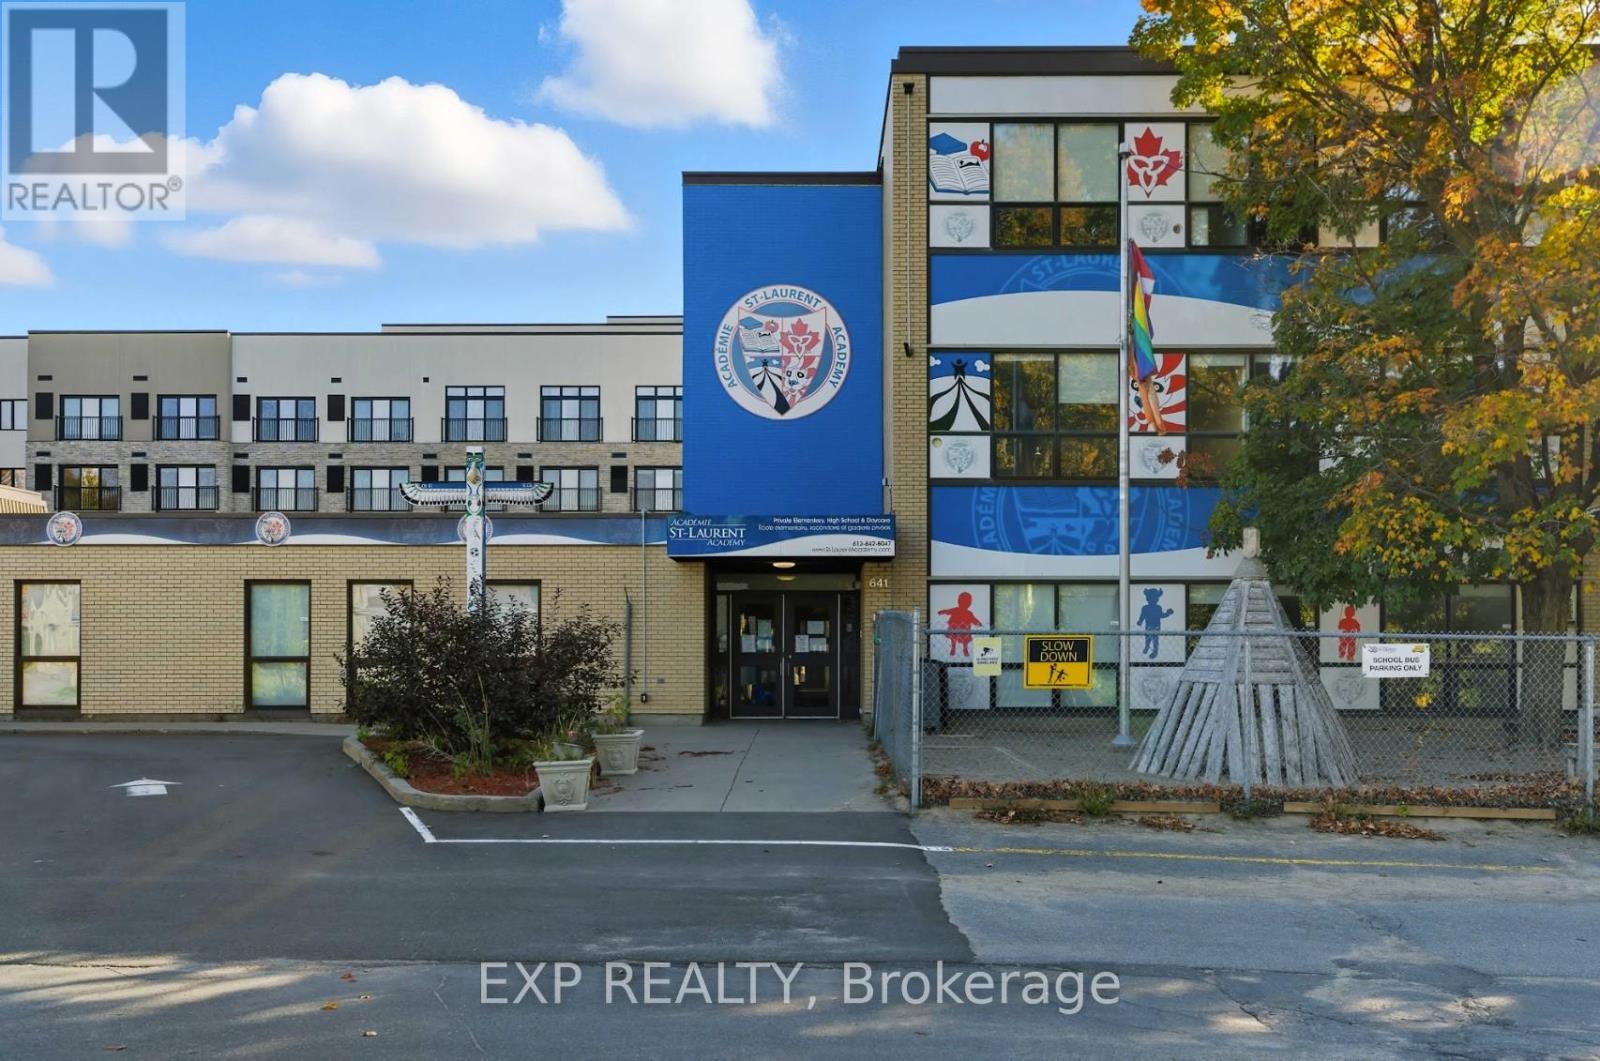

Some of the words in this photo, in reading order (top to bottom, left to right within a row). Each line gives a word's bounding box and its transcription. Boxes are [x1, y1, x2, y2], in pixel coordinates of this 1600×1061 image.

[744, 288, 822, 309] ST-LAURENT
[718, 323, 738, 388] ACADÉMIE
[831, 326, 847, 389] ACADEMY
[669, 528, 746, 539] ST-LAURENT
[869, 578, 889, 588] 641
[1042, 641, 1074, 651] SLOW
[1040, 651, 1077, 662] DOWN
